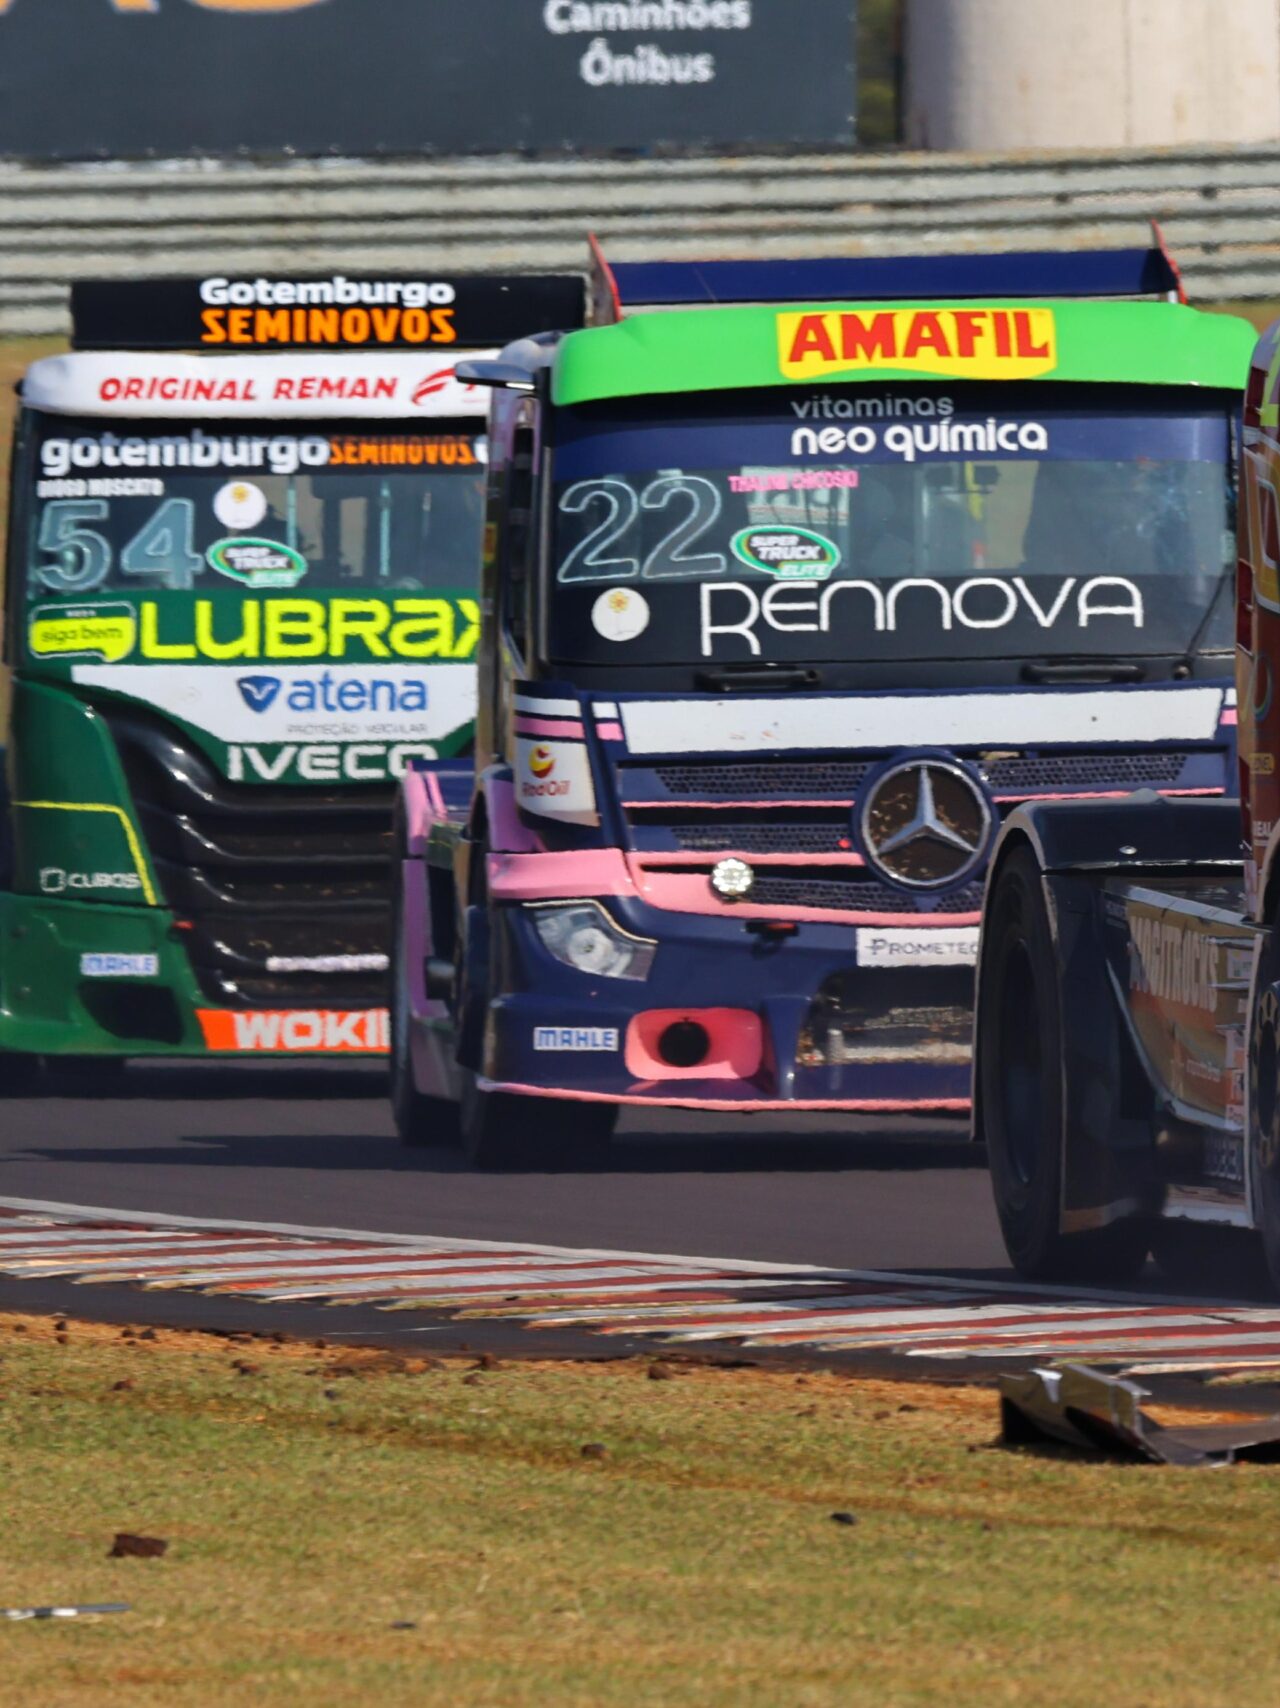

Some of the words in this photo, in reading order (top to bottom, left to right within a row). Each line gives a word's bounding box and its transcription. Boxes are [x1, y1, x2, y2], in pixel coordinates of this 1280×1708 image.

[579, 37, 716, 86] Ônibus
[200, 276, 456, 308] Gotemburgo
[200, 308, 457, 343] SEMINOVOS
[788, 311, 1050, 362] AMAFIL
[100, 377, 257, 401] ORIGINAL
[274, 377, 398, 400] REMAN
[791, 394, 955, 419] vitaminas
[791, 425, 877, 456] neo
[884, 417, 1049, 462] química
[36, 498, 205, 591] 54
[558, 476, 728, 582] 22
[757, 546, 821, 560] TRUCK
[287, 671, 428, 712] atena
[232, 1008, 391, 1050] WOKI
[537, 1029, 614, 1048] MAHLE
